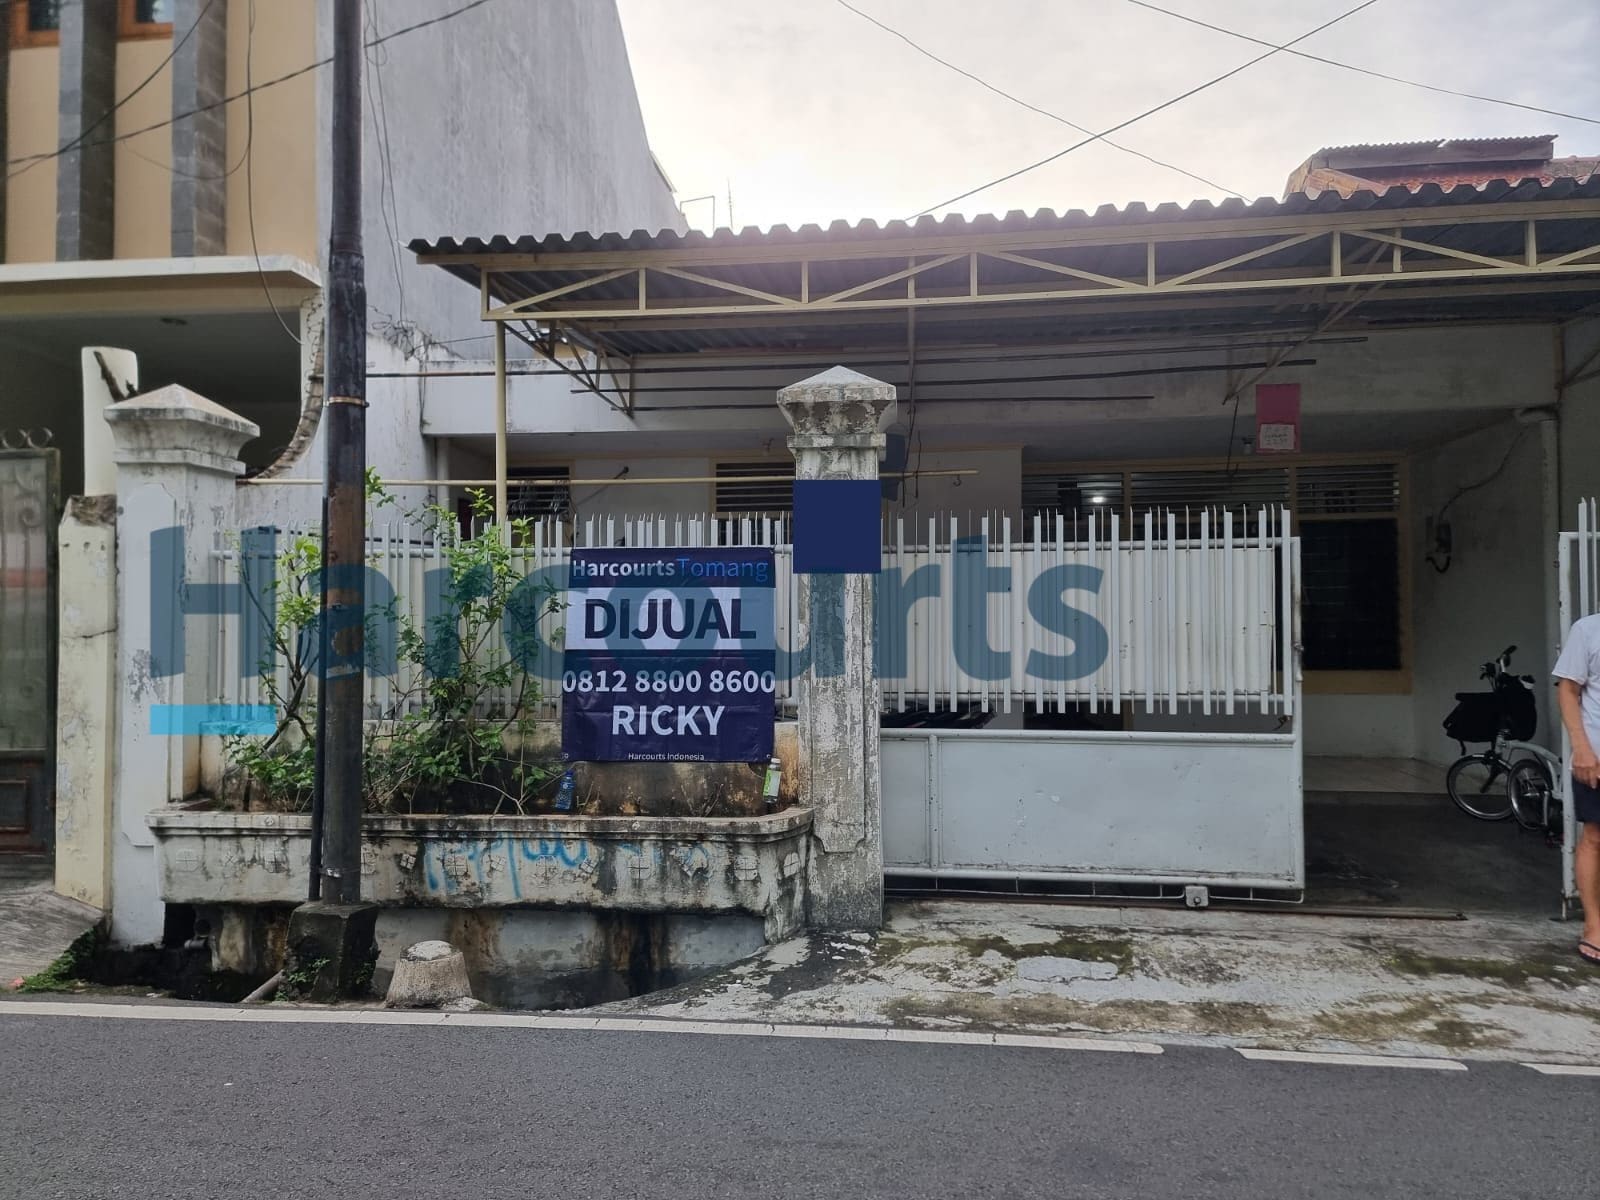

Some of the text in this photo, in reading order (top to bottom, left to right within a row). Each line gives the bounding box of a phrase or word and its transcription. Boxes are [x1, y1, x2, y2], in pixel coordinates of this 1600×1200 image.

[573, 558, 770, 582] Harcourts Tomang
[584, 598, 757, 640] DIJUAL
[562, 670, 776, 693] 0812 8800 8600
[612, 704, 726, 736] RICKY
[628, 752, 705, 761] Harcourts Indonesia
